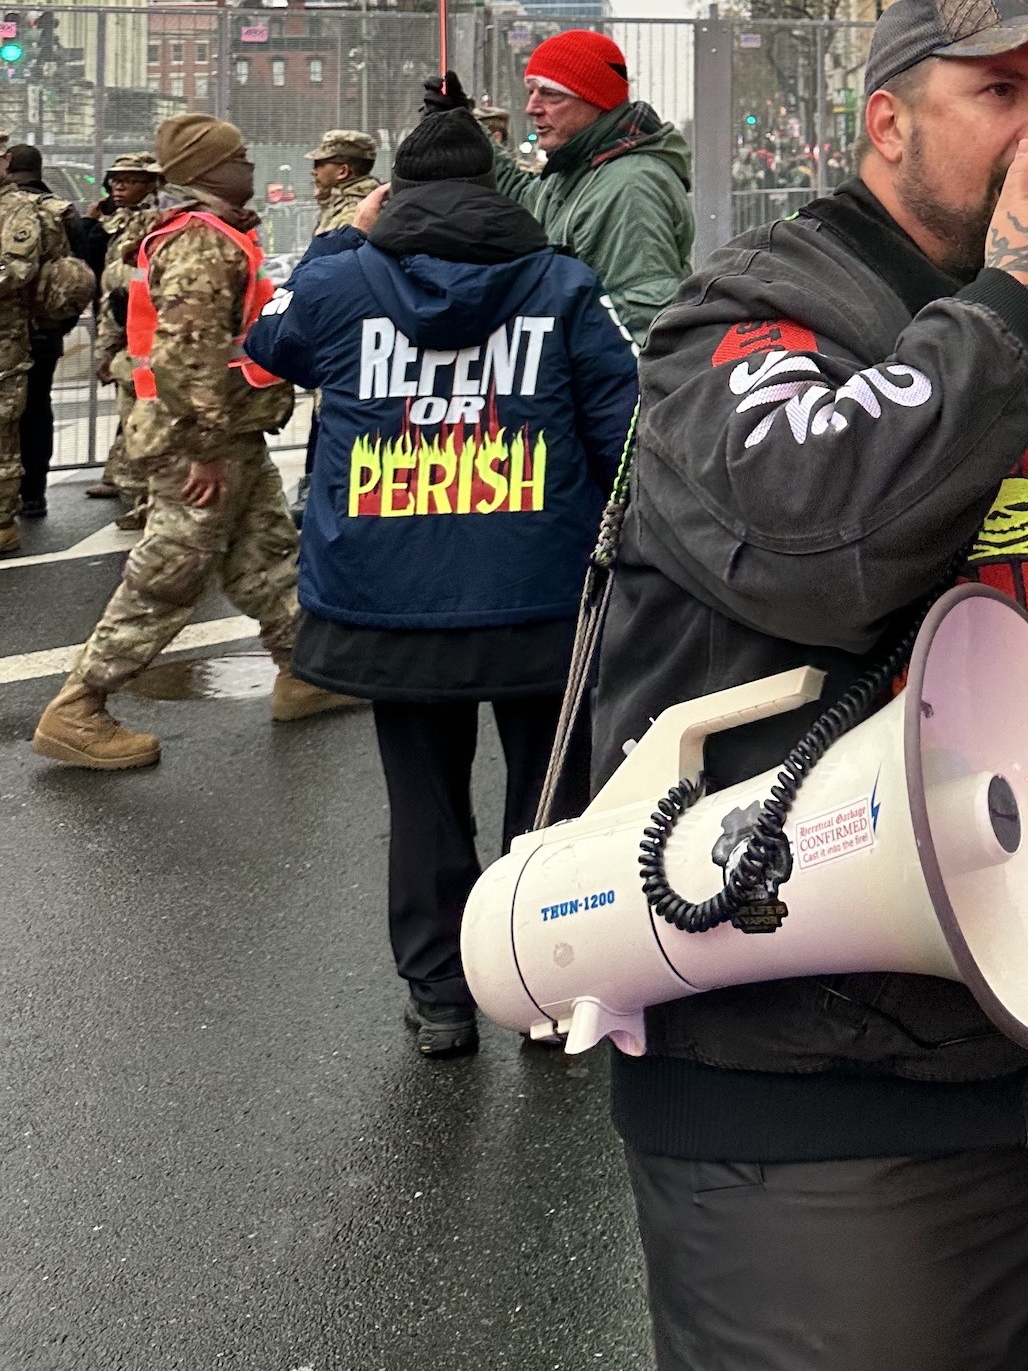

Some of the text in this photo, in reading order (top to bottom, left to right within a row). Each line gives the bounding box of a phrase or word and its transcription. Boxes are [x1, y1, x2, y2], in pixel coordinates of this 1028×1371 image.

[358, 316, 555, 400] REPENT
[410, 396, 485, 425] OR
[348, 426, 547, 517] PERISH
[836, 807, 866, 824] Garbage
[800, 817, 868, 851] CONFIRMED
[803, 851, 819, 863] Cast
[820, 848, 826, 857] it
[827, 844, 841, 855] into
[843, 839, 854, 849] the
[541, 890, 615, 921] THUN-1200
